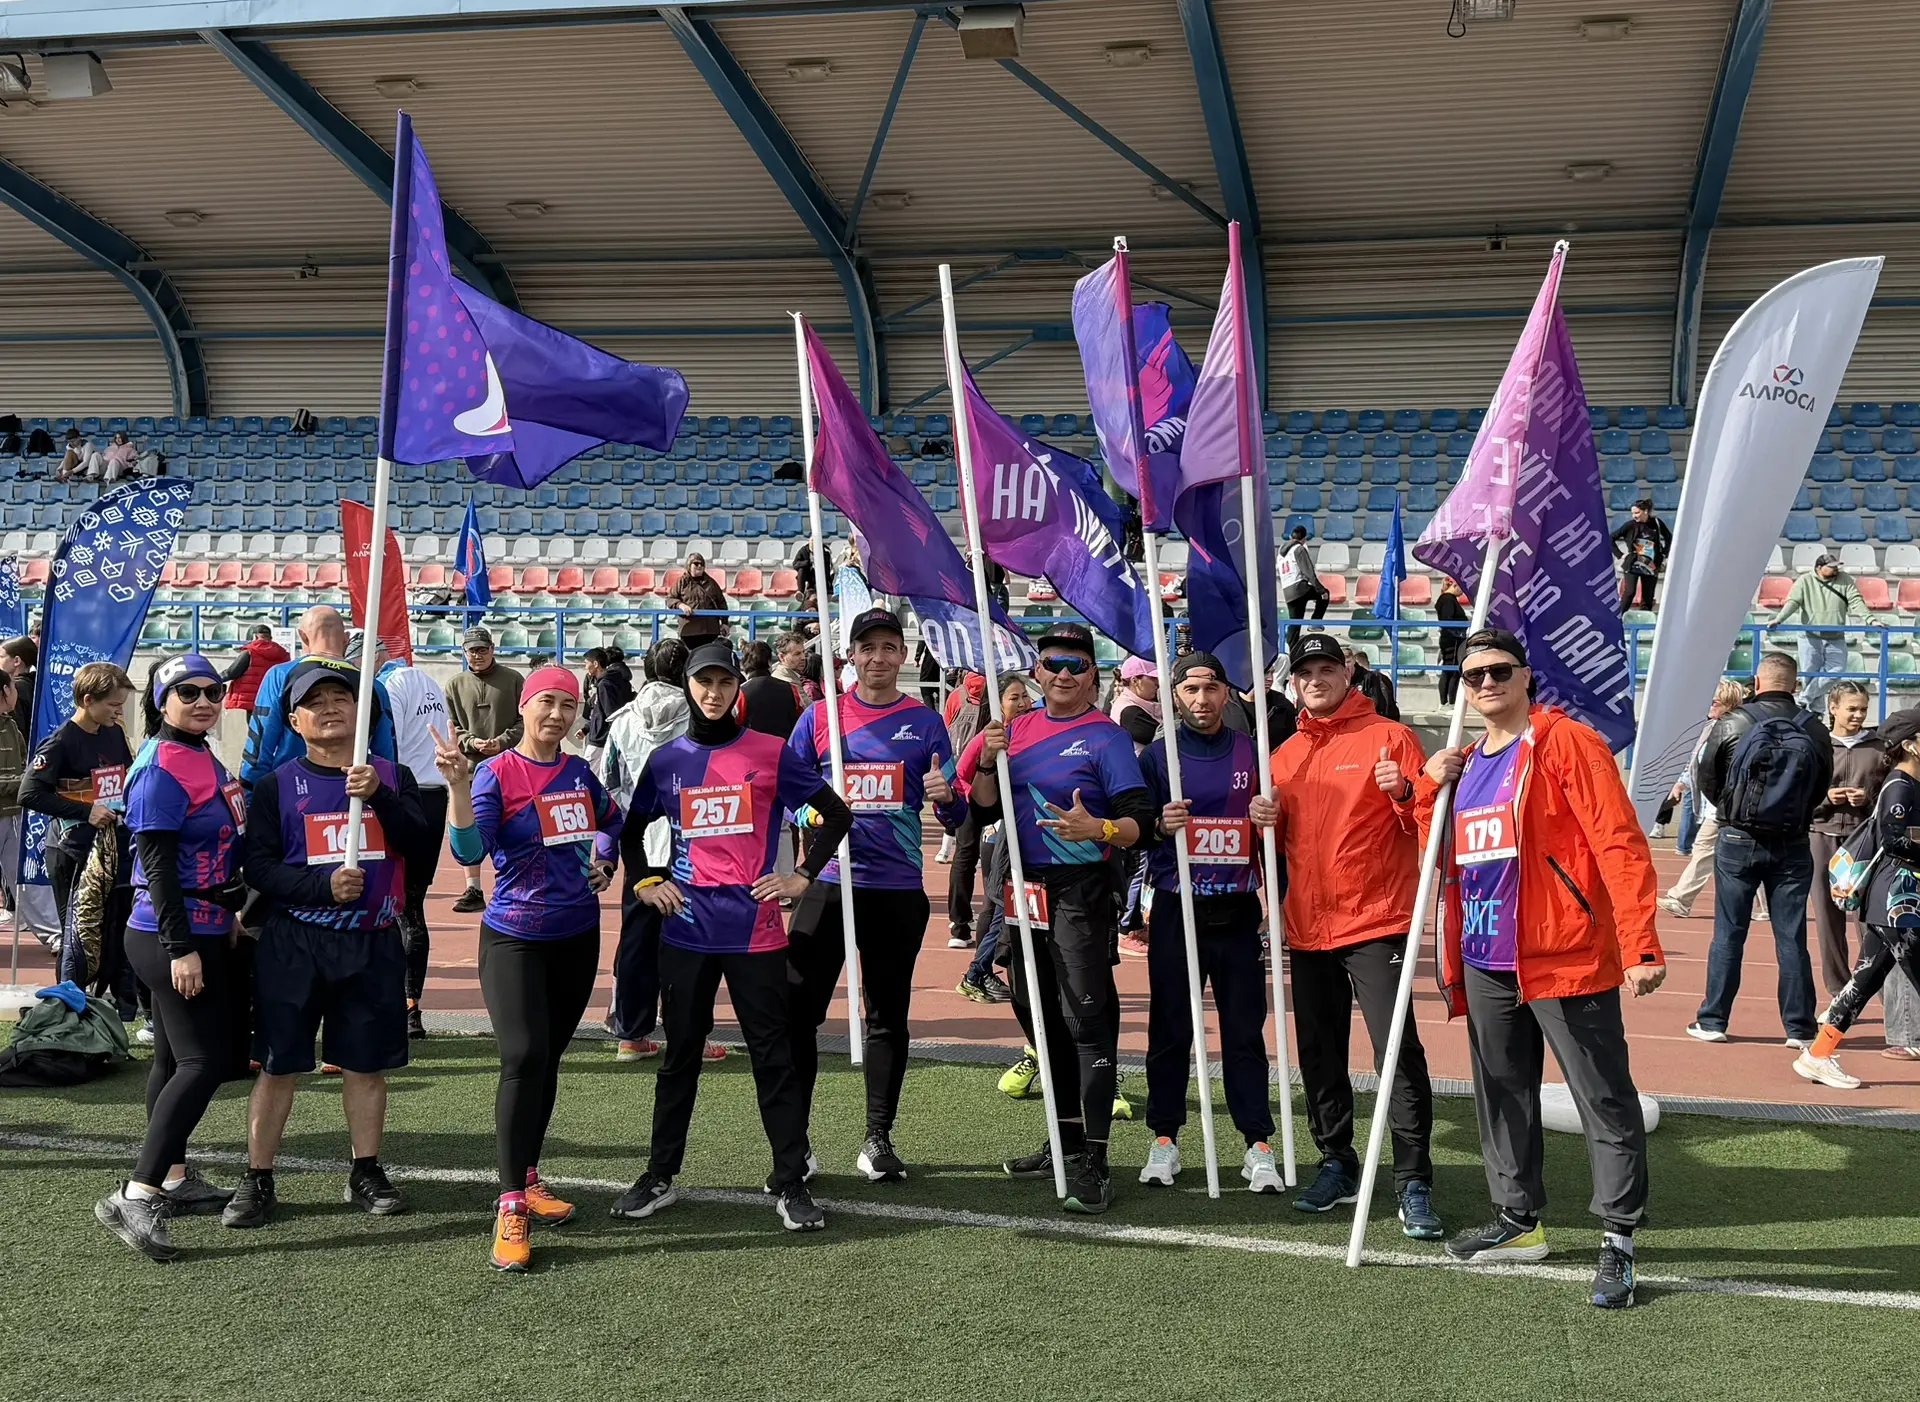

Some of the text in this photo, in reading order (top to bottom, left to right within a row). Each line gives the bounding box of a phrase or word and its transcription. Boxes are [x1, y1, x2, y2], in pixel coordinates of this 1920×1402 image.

[1739, 383, 1815, 412] АЛРОСА
[992, 461, 1048, 522] НА
[97, 774, 122, 798] 252
[846, 774, 893, 801] 204
[1232, 771, 1249, 789] 33
[549, 802, 589, 833] 158
[691, 795, 740, 827] 257
[1194, 828, 1241, 855] 203
[1465, 817, 1503, 851] 179
